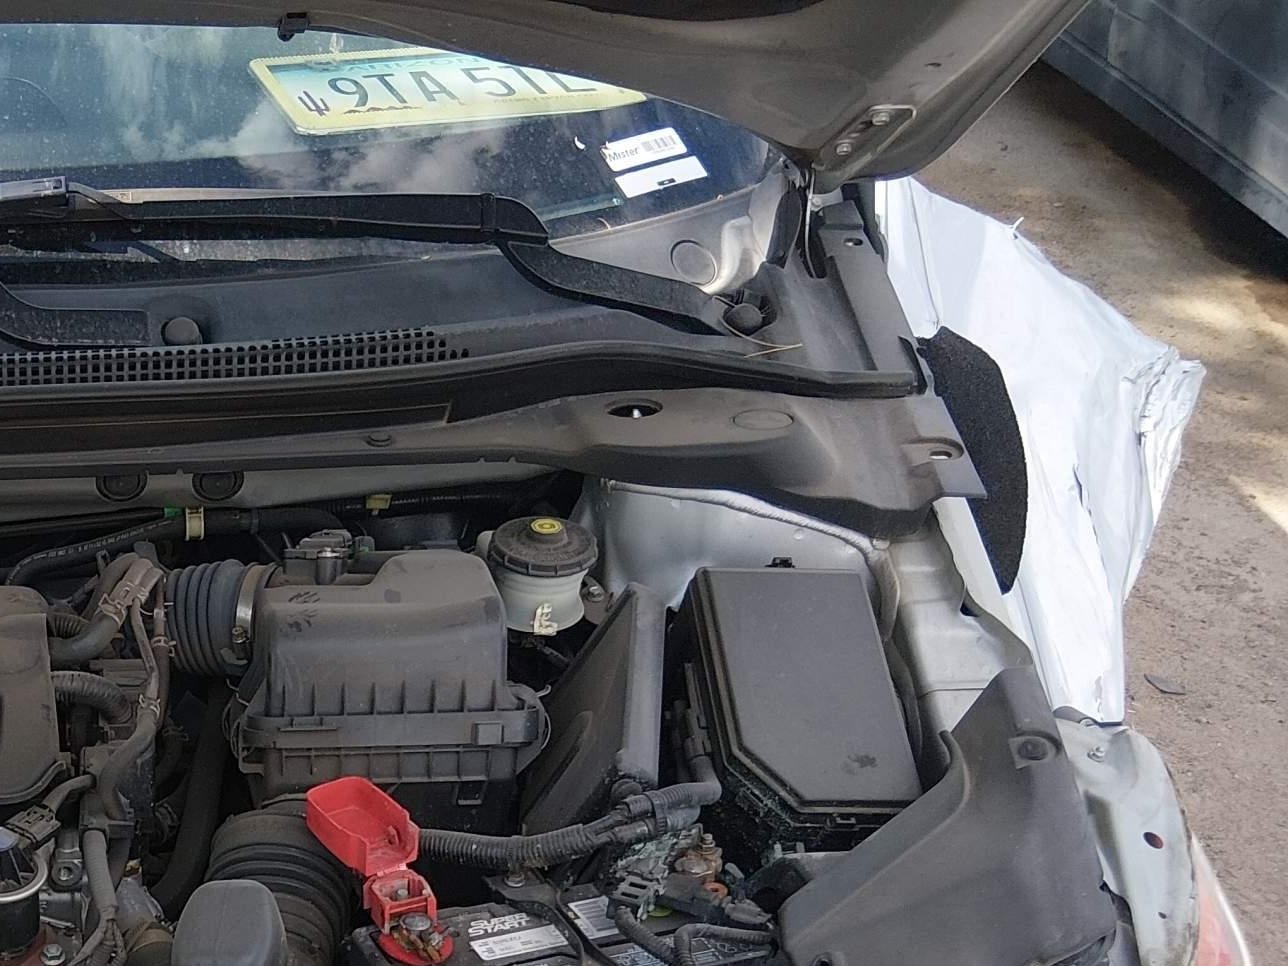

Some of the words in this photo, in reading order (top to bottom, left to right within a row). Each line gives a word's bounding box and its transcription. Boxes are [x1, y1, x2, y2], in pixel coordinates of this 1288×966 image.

[347, 56, 481, 71] ARIZON
[608, 147, 638, 162] Mister
[470, 912, 531, 928] SUPER
[468, 919, 528, 938] START
